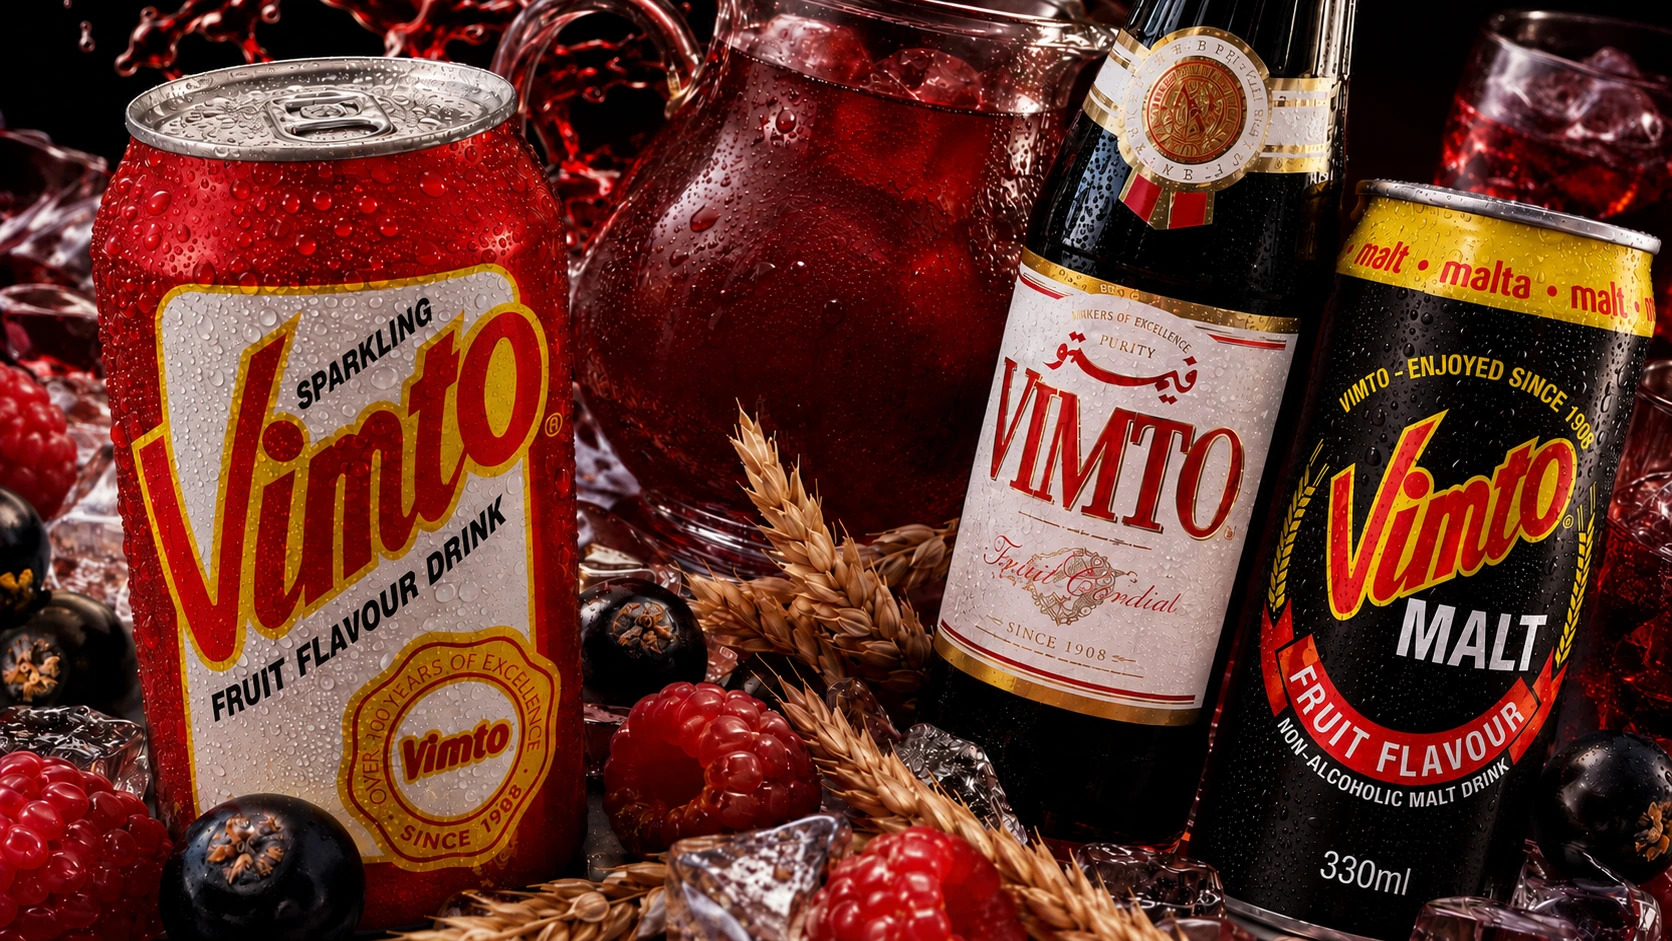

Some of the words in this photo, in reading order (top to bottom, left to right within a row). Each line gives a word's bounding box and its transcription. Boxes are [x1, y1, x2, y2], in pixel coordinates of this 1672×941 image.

[1354, 241, 1409, 274] malt
[1439, 260, 1531, 299] malta
[1571, 281, 1628, 318] malt
[296, 298, 433, 409] SPARKLING
[1100, 334, 1156, 359] PURITY
[1117, 312, 1132, 323] OF
[1134, 316, 1193, 354] EXCELLENCE
[1339, 367, 1390, 413] VIMTO
[1407, 354, 1504, 381] ENJOYED
[1509, 366, 1568, 412] SINCE
[1564, 405, 1595, 450] 1908
[134, 306, 548, 669] Vimto
[990, 356, 1245, 541] VIMTO
[1326, 409, 1577, 620] Vimto
[211, 658, 286, 723] FRUIT
[298, 570, 420, 677] FLAVOUR
[428, 494, 506, 587] DRINK
[1007, 622, 1057, 649] SINCE
[1065, 641, 1107, 661] 1908
[1396, 598, 1547, 672] MALT
[362, 750, 387, 805] OVER
[384, 659, 443, 707] YEARS
[451, 653, 477, 671] OF
[483, 654, 542, 753] EXCELLENCE
[402, 721, 511, 782] Vimto
[1277, 717, 1403, 807] NON-ALCOHOLIC
[1409, 786, 1456, 808] MALT
[1461, 757, 1511, 798] DRINK
[1289, 665, 1370, 759] FRUIT
[1376, 701, 1525, 777] FLAVOUR
[401, 824, 470, 850] SINCE
[1320, 850, 1411, 896] 330ml
